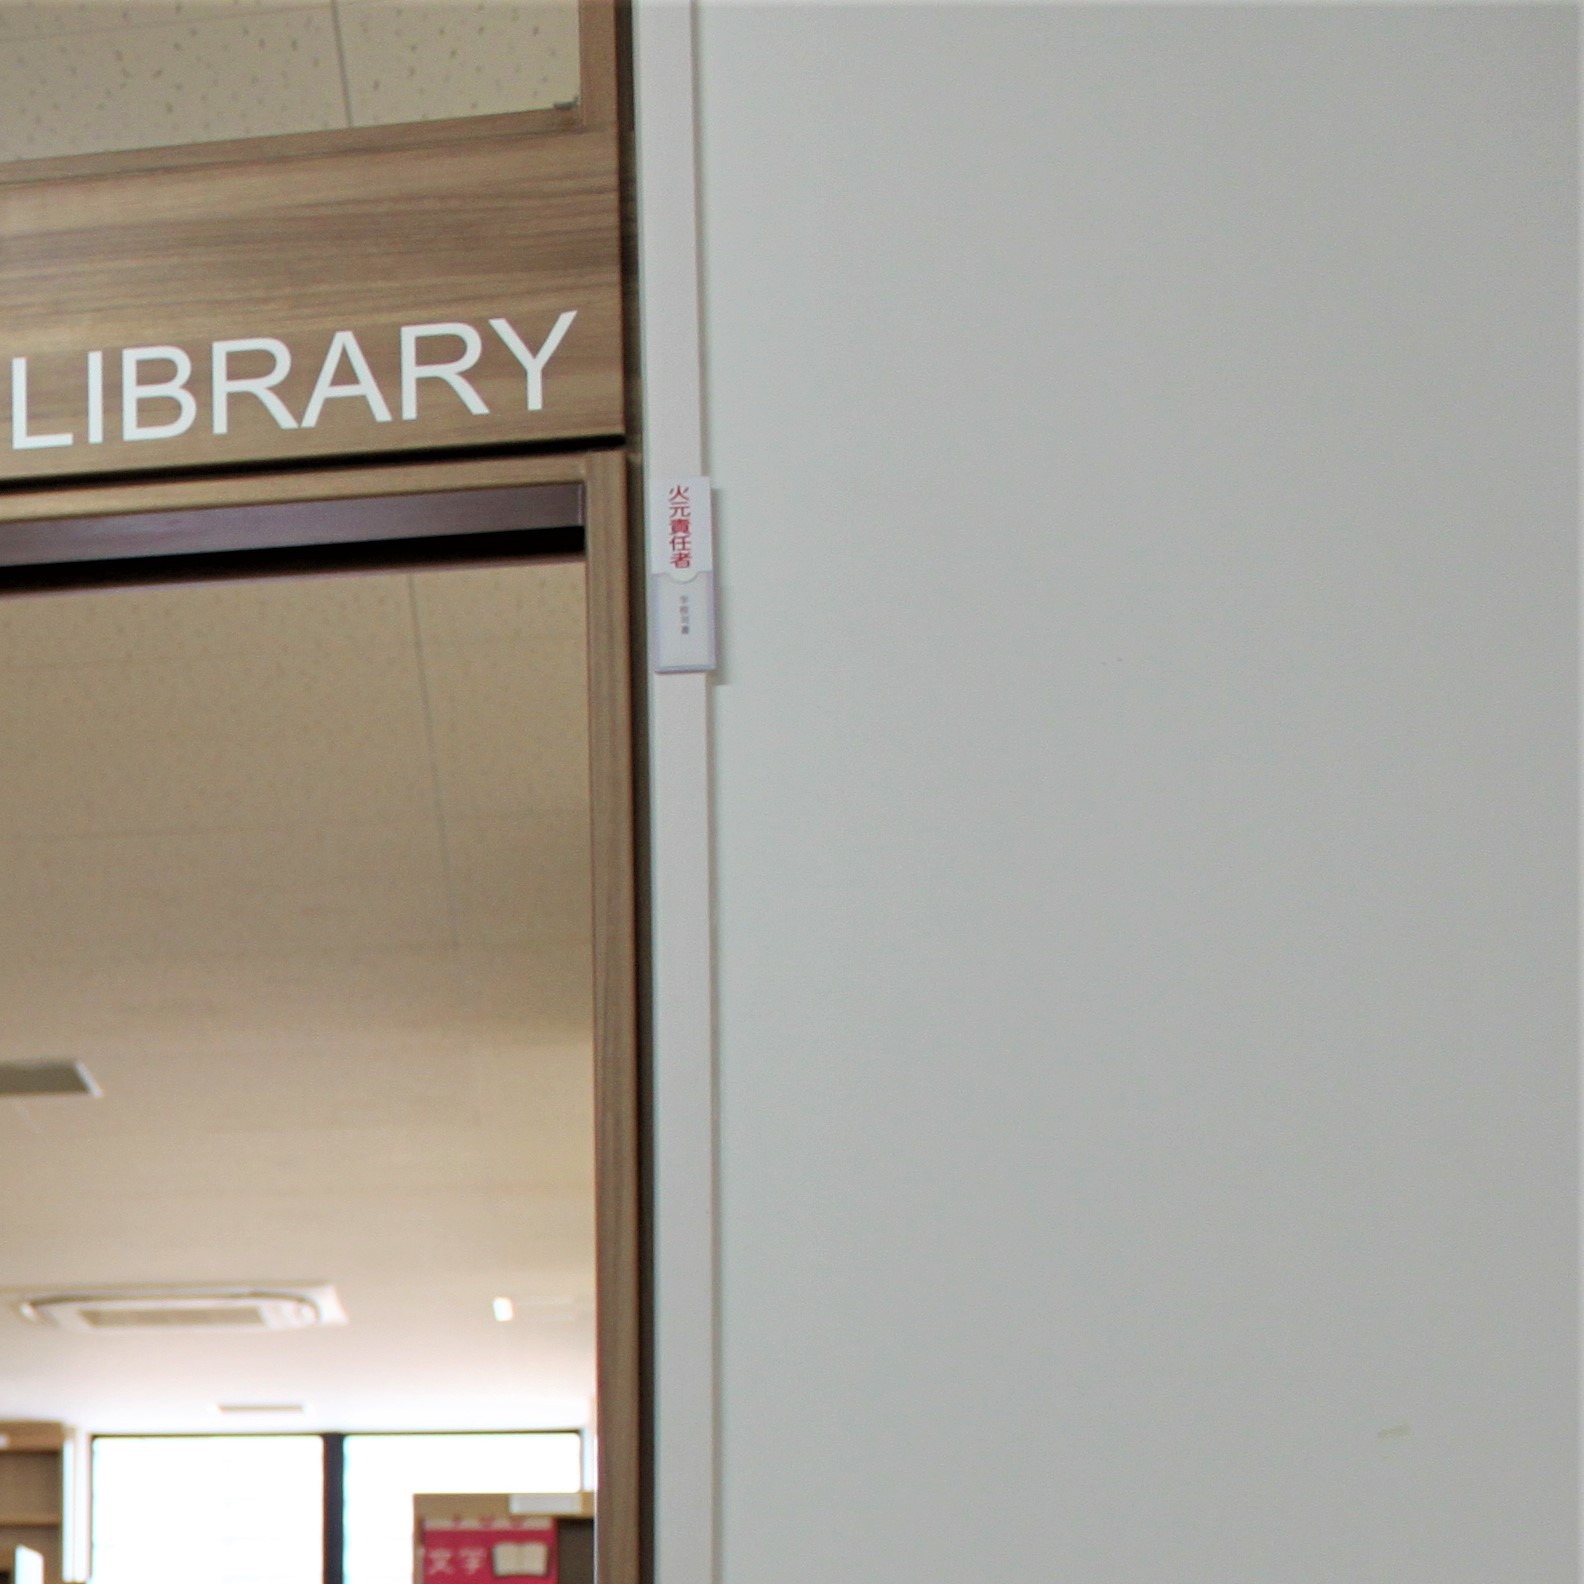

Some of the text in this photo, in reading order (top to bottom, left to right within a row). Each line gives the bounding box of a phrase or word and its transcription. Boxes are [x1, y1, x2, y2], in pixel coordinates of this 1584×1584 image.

[12, 311, 579, 449] LIBRARY
[668, 485, 692, 569] 火元責任者
